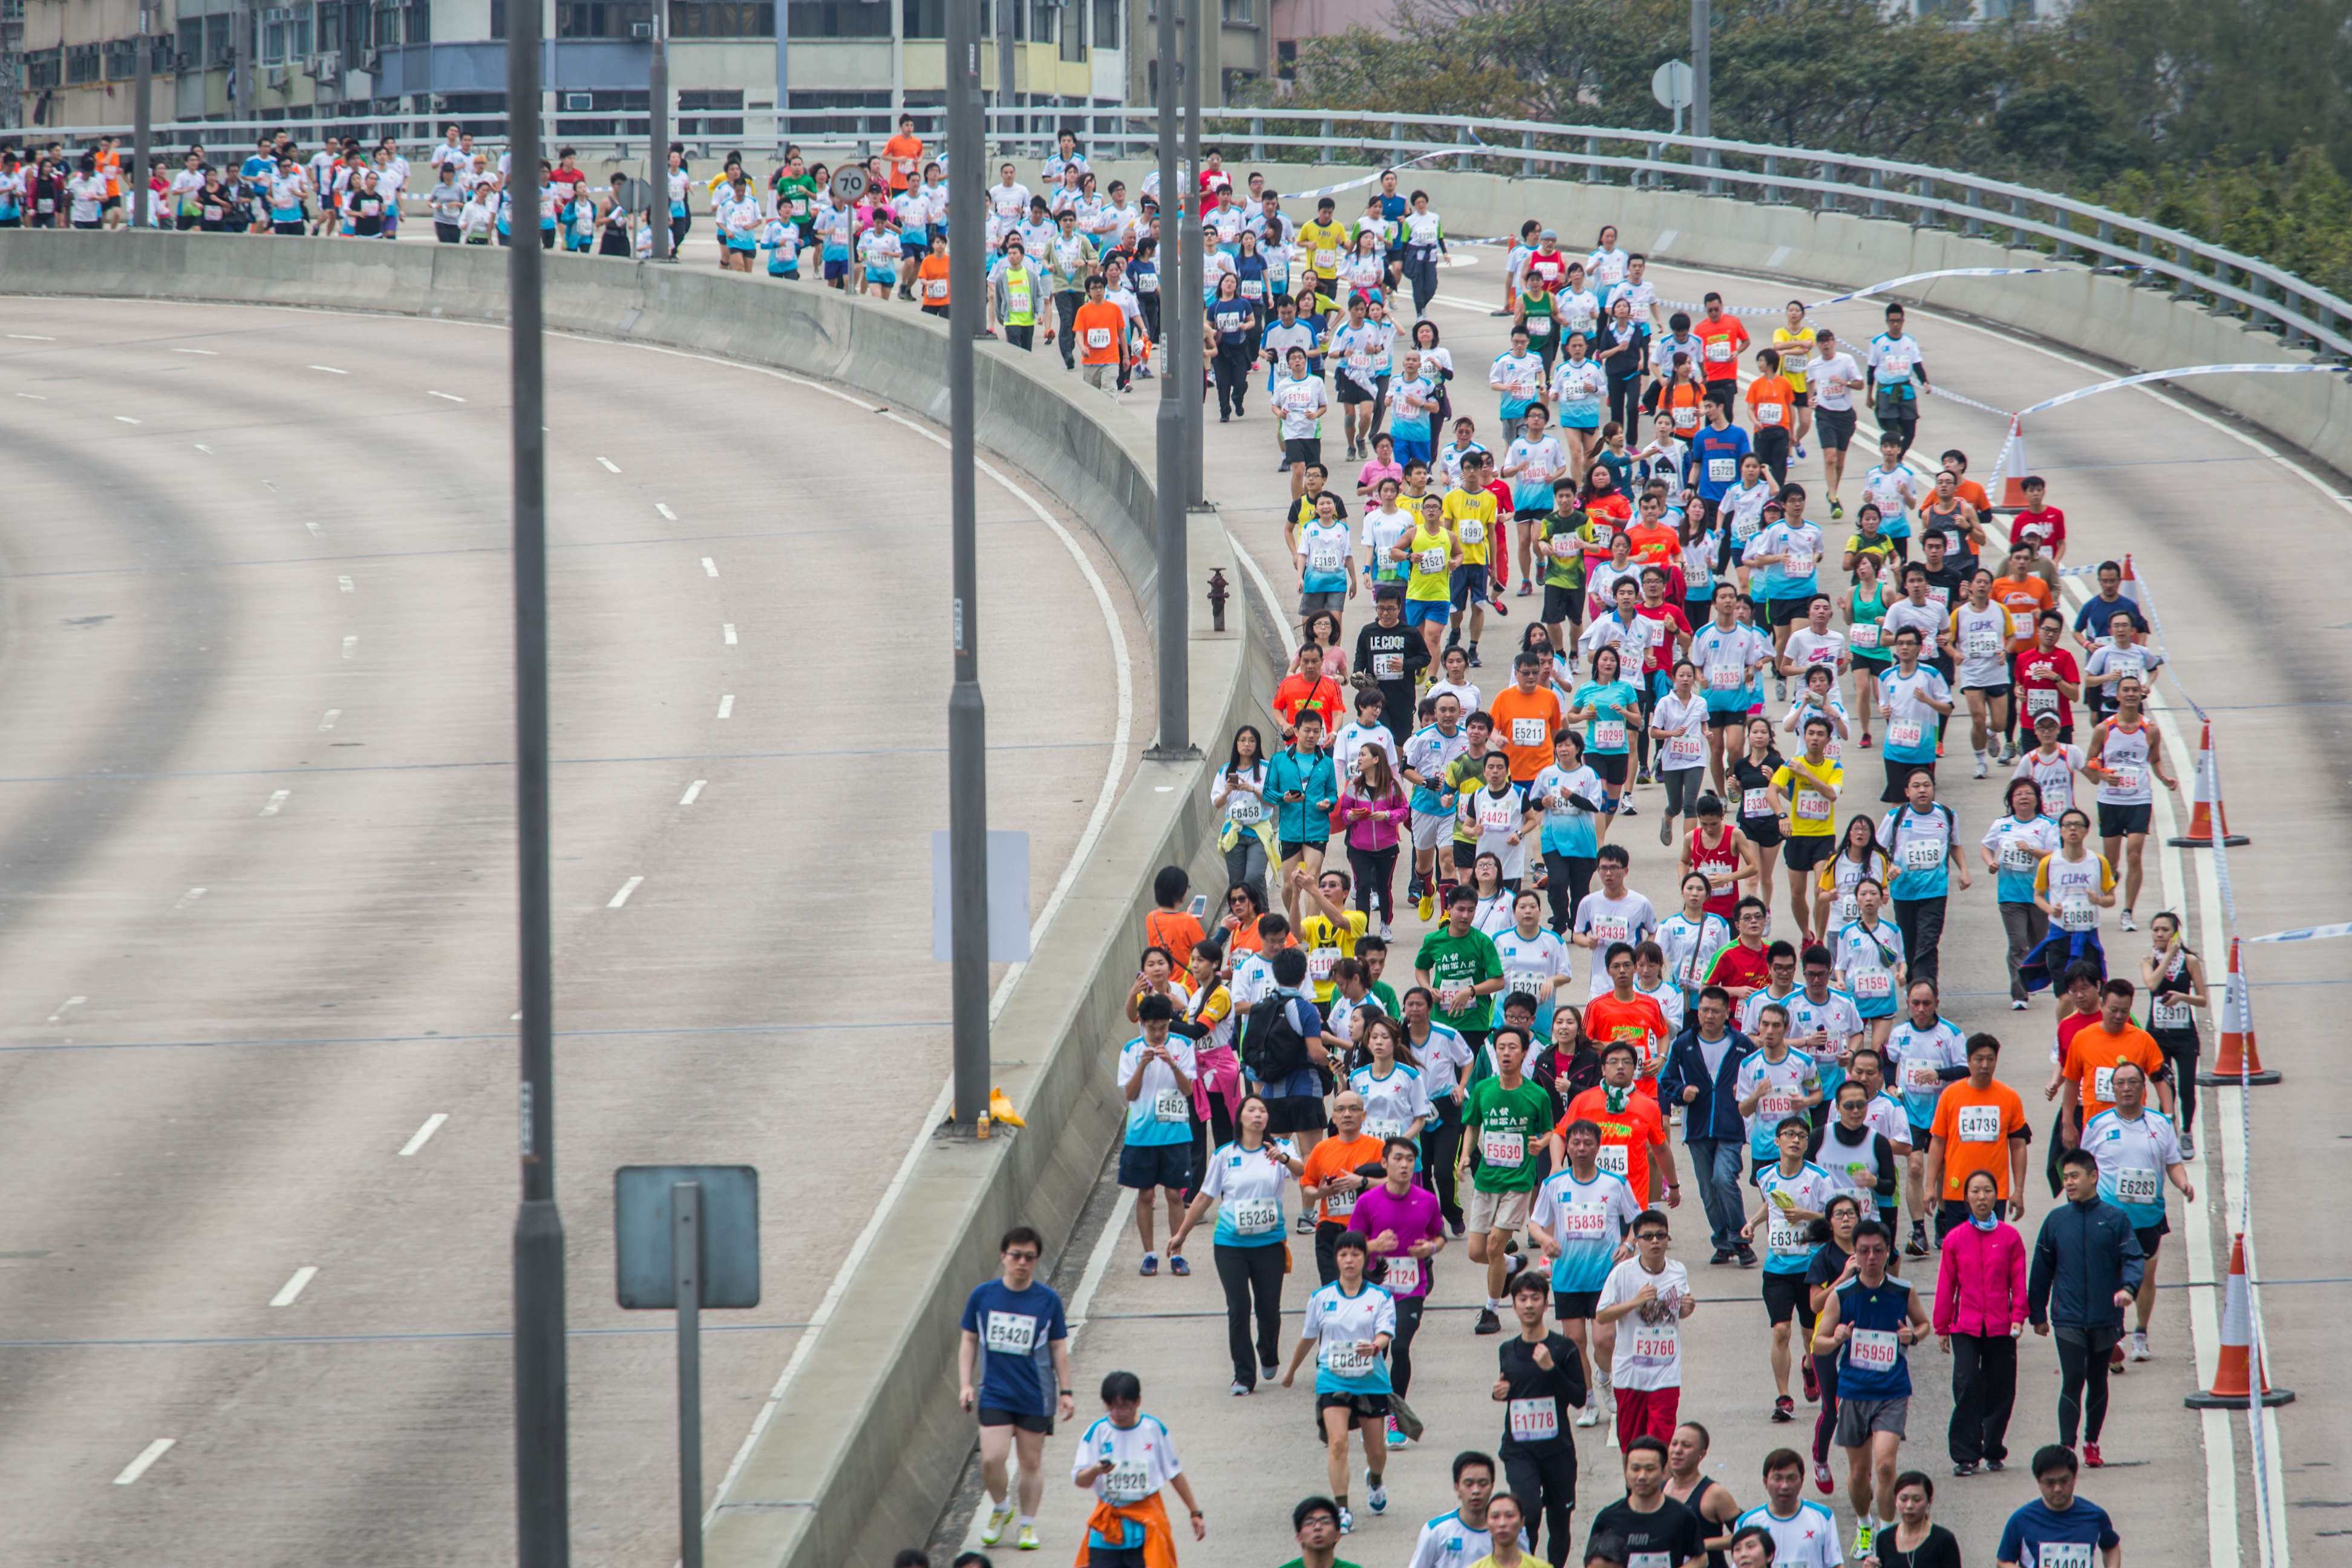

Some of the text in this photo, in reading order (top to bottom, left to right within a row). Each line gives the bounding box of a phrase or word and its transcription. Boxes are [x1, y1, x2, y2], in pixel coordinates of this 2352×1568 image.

[841, 177, 861, 191] 70
[1711, 466, 1733, 475] E5720
[1460, 528, 1481, 537] E4997
[1315, 556, 1336, 566] E3198
[1422, 557, 1443, 569] E1521
[1619, 656, 1636, 668] 912
[1715, 672, 1739, 684] F3335
[1515, 727, 1542, 738] E5211
[1598, 730, 1622, 740] F0299
[1673, 743, 1699, 754] F5104
[1747, 798, 1768, 809] F330
[1801, 800, 1828, 813] F4360
[1232, 807, 1259, 817] E6458
[1483, 812, 1508, 823] F4421
[2062, 874, 2091, 885] CUHK
[2064, 910, 2093, 923] E0680
[1596, 928, 1624, 939] F5439
[1858, 979, 1888, 990] F1594
[2156, 1007, 2187, 1021] E2917
[1763, 1099, 1791, 1112] F065
[1962, 1119, 1997, 1132] E4739
[1487, 1142, 1521, 1158] F5630
[1597, 1157, 1624, 1171] 3845
[2121, 1180, 2154, 1195] E6283
[1328, 1191, 1357, 1208] E519
[1240, 1210, 1275, 1226] E5236
[1567, 1213, 1604, 1230] F5835
[1387, 1269, 1416, 1285] 1124
[991, 1324, 1028, 1345] E5420
[1636, 1341, 1674, 1355] F3760
[1855, 1342, 1894, 1362] F5950
[1515, 1412, 1553, 1429] F1778
[1106, 1474, 1146, 1490] E0920
[1627, 1534, 1650, 1546] RUN
